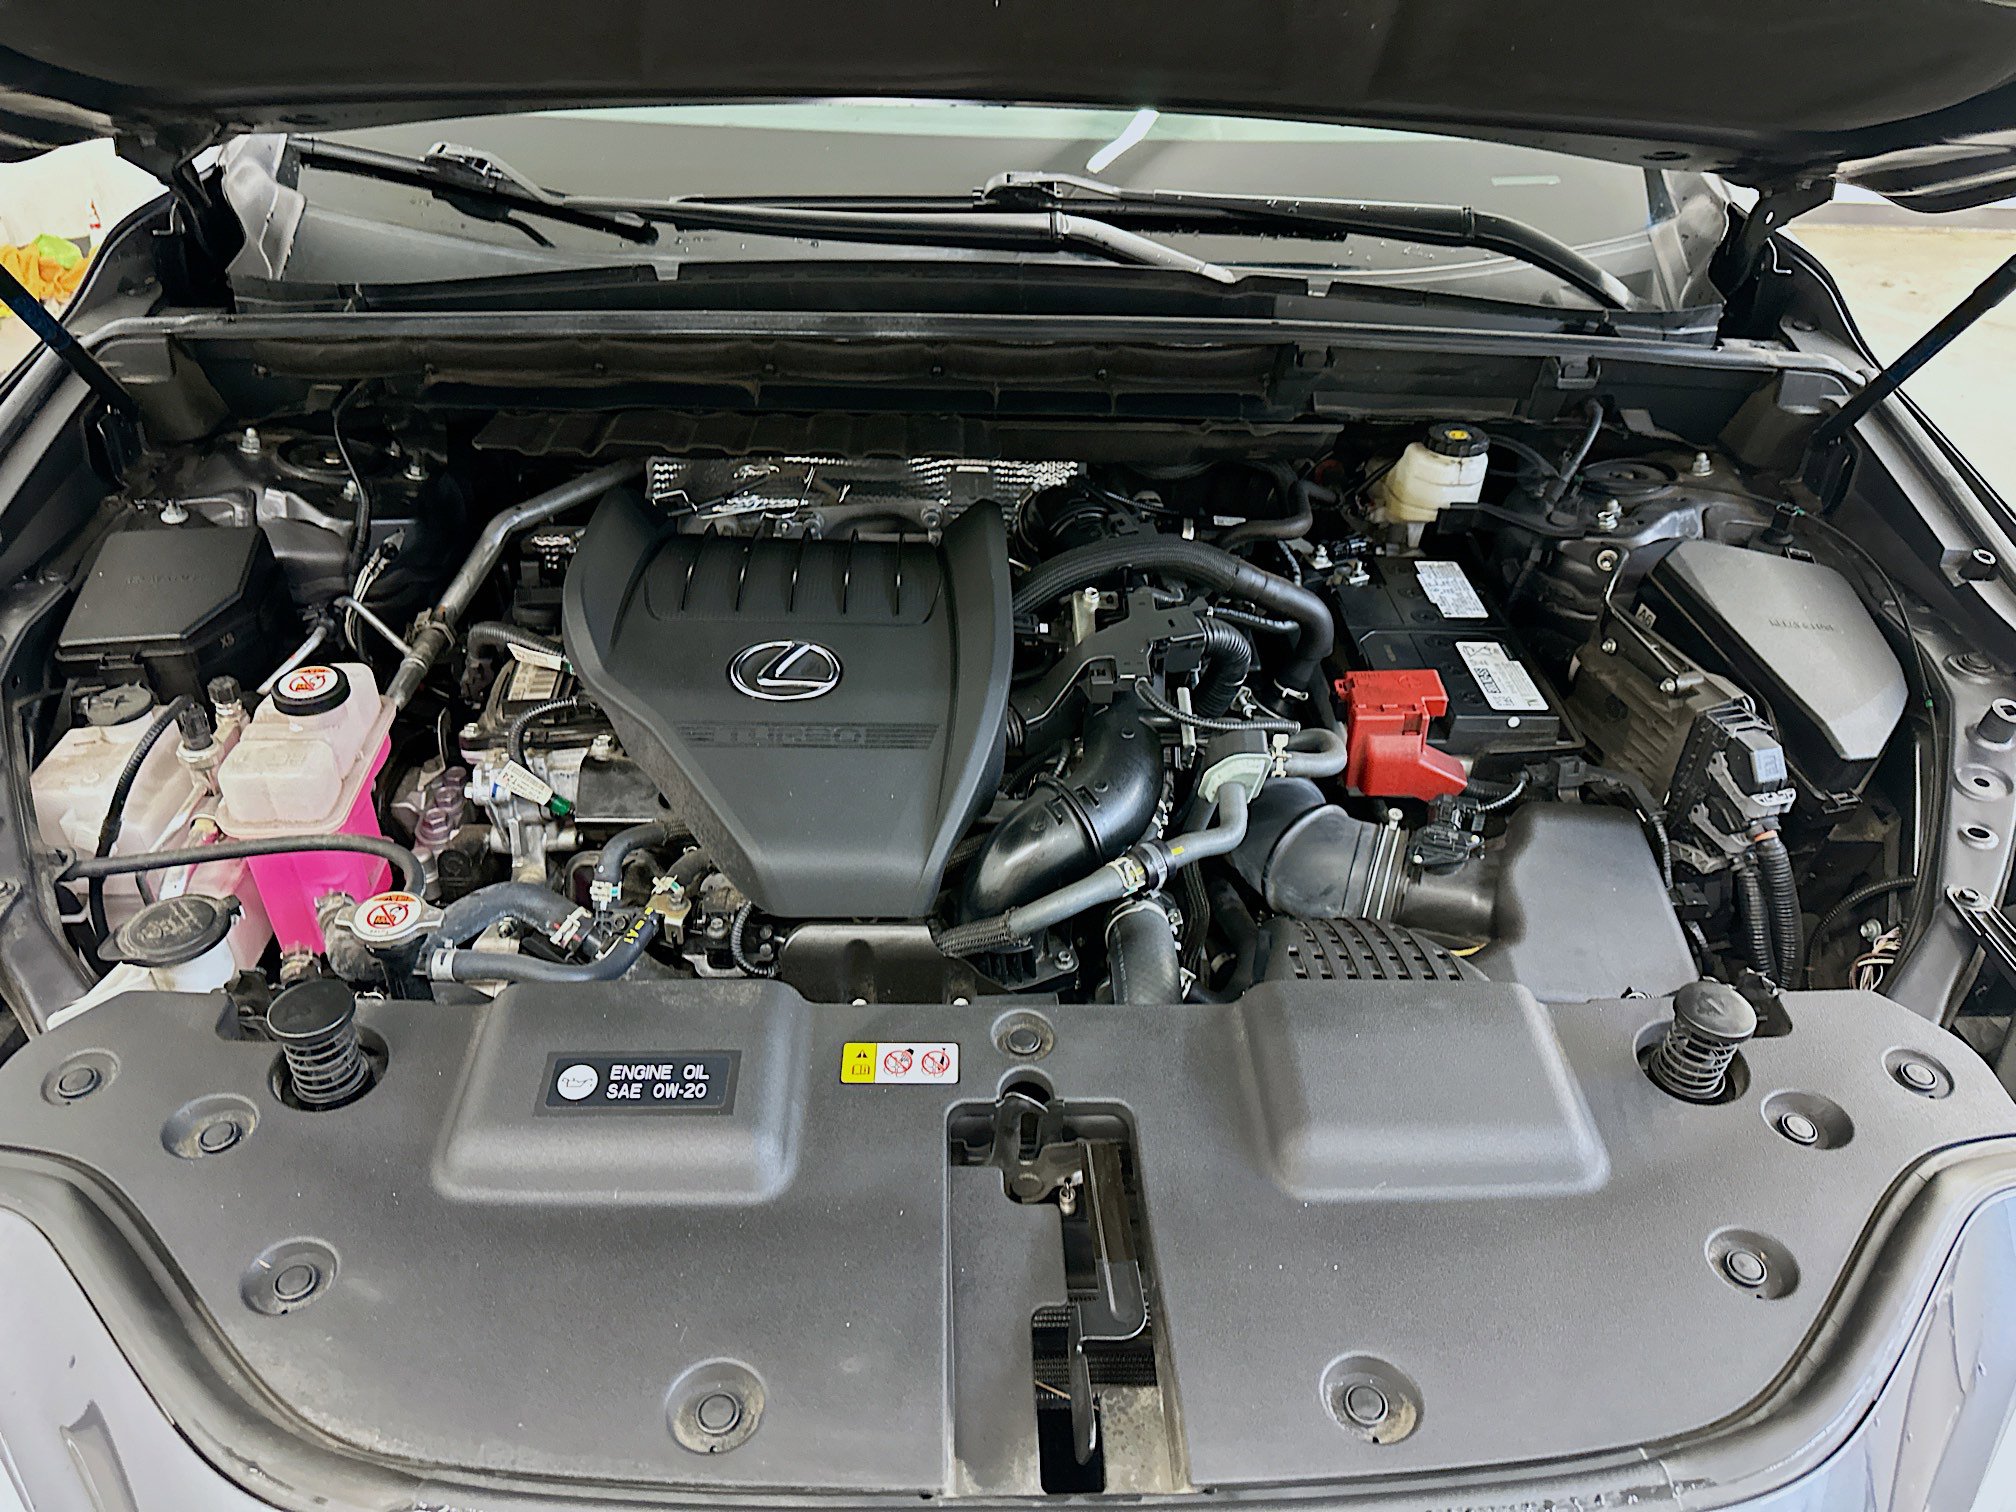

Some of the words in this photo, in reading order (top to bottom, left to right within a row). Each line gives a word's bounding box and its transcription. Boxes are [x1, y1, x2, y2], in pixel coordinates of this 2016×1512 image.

[609, 1064, 674, 1081] ENGINE
[683, 1064, 710, 1080] OIL
[606, 1083, 643, 1099] SAE
[652, 1082, 708, 1099] 0W-20
